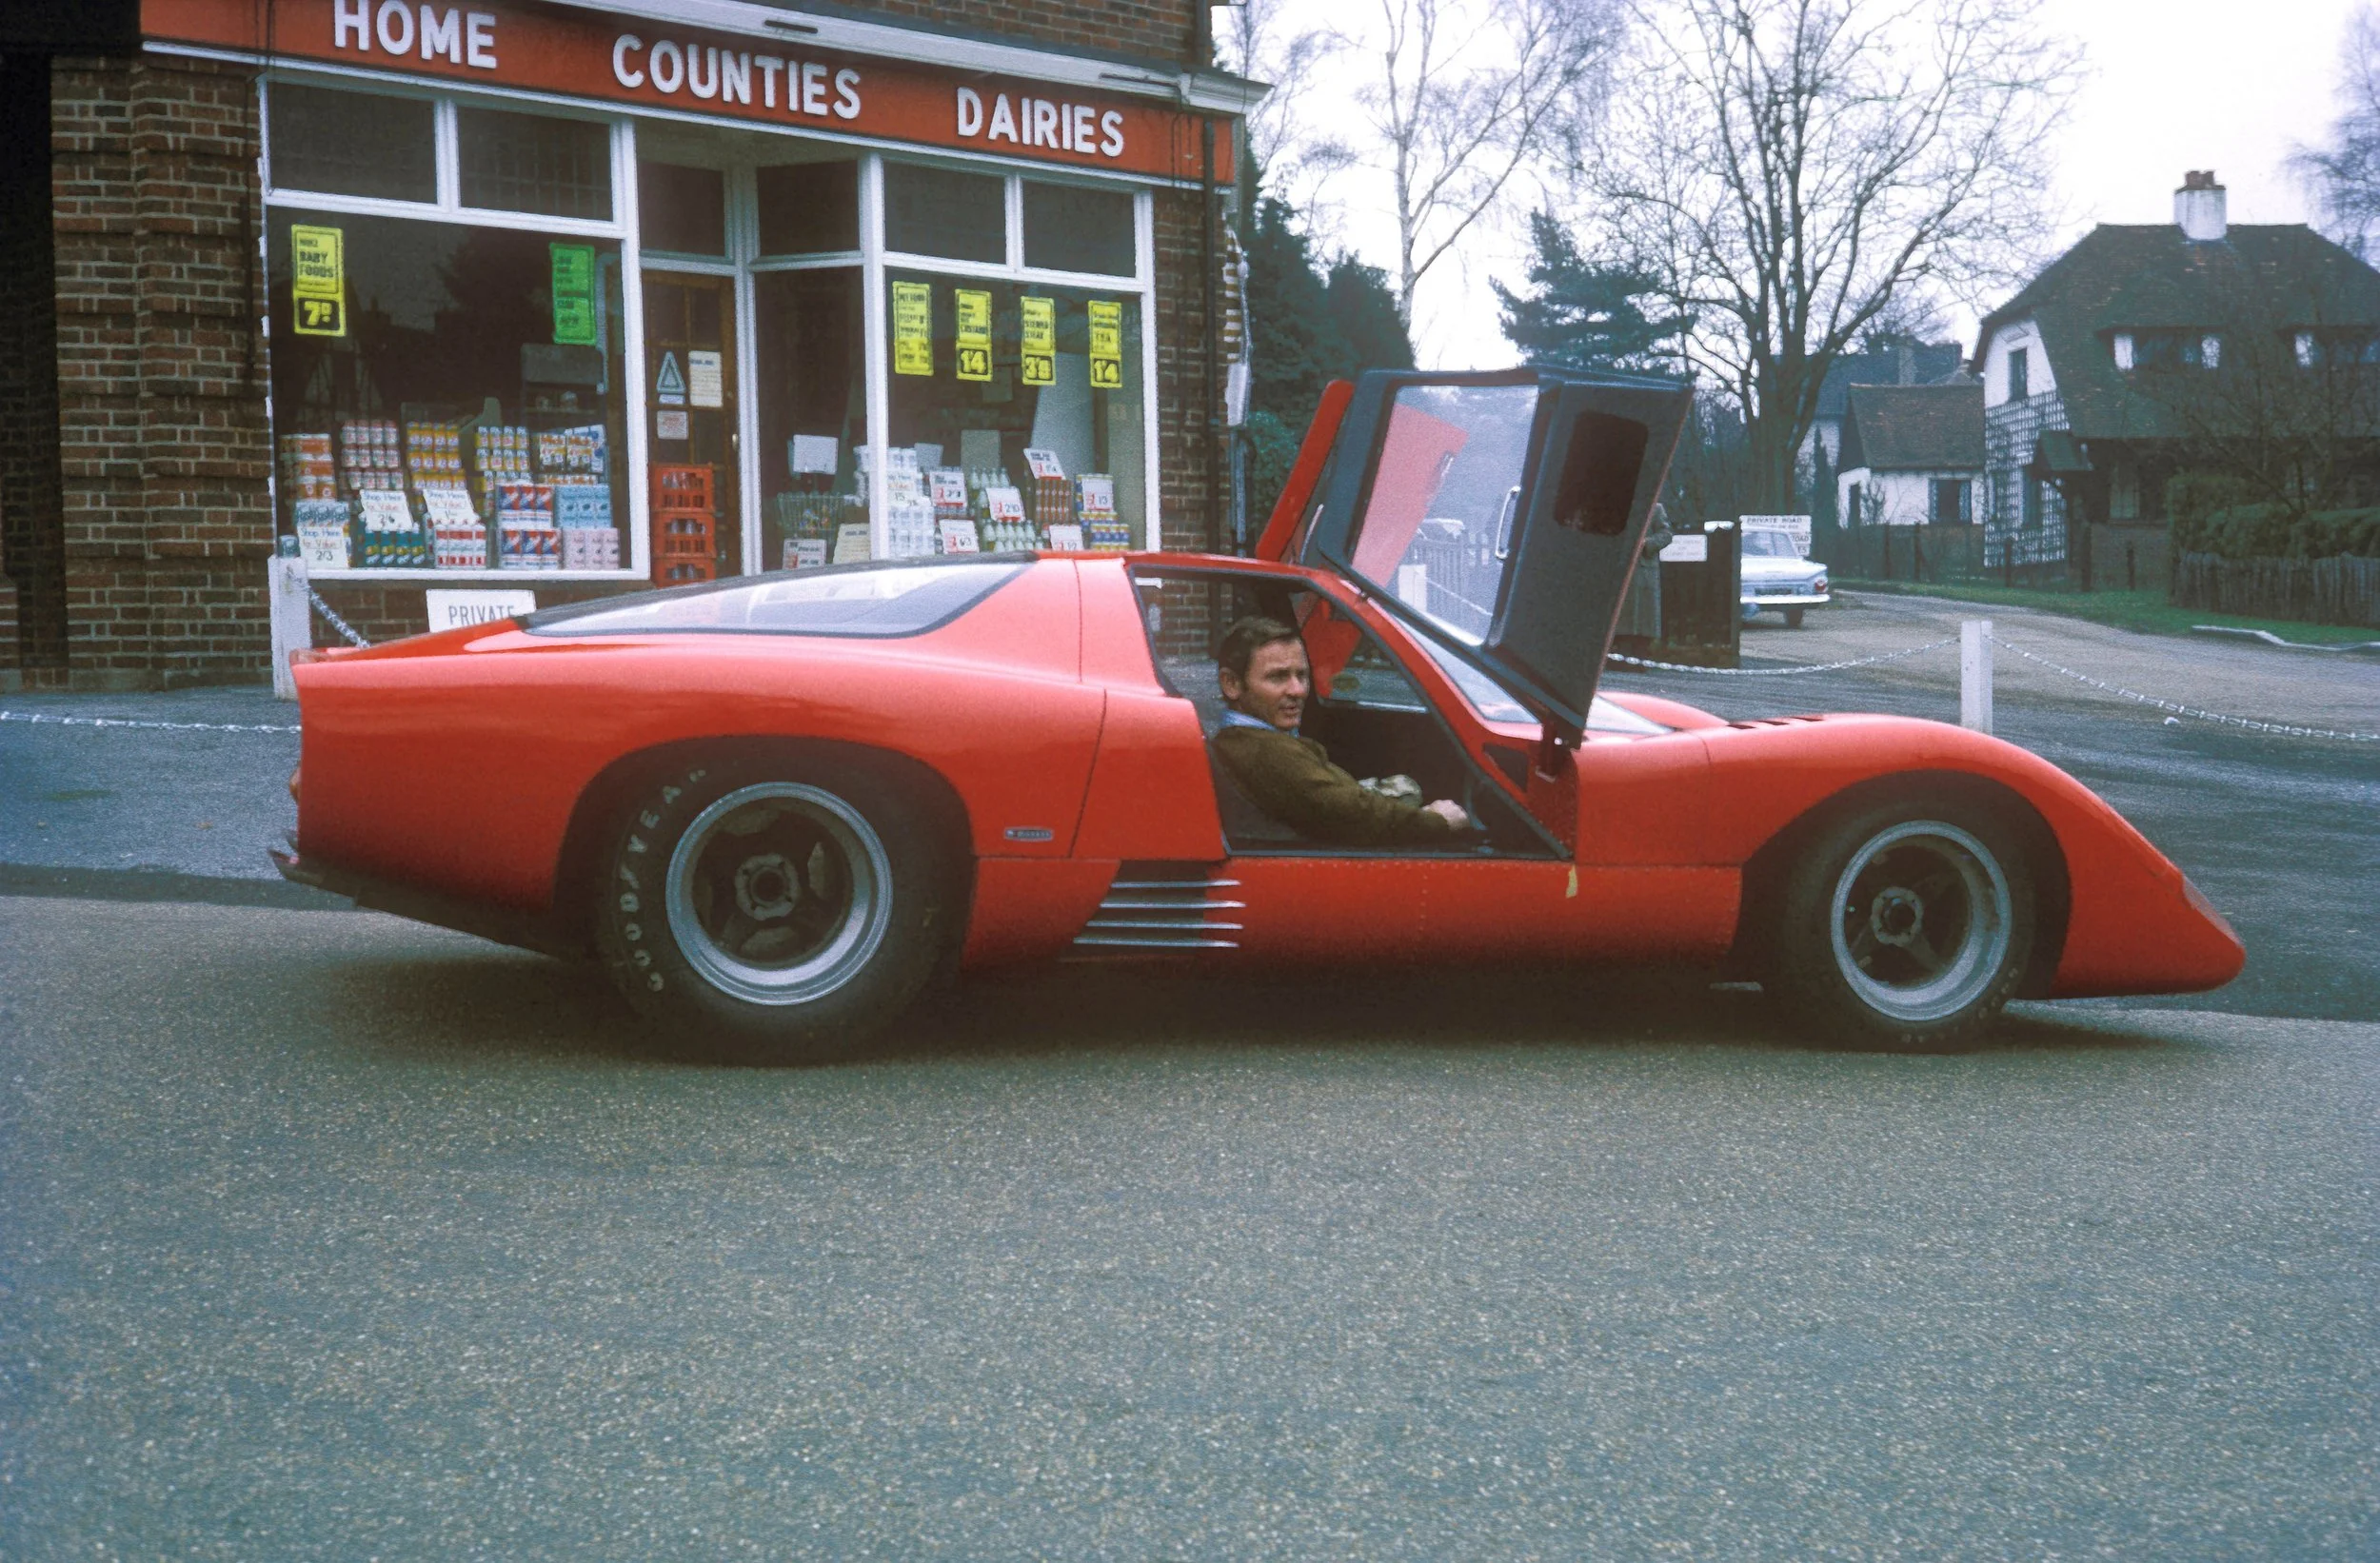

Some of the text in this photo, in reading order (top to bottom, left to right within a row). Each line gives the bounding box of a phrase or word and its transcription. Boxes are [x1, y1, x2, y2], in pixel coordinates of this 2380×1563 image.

[334, 0, 1124, 157] HOME COUNTIES DAIRIES
